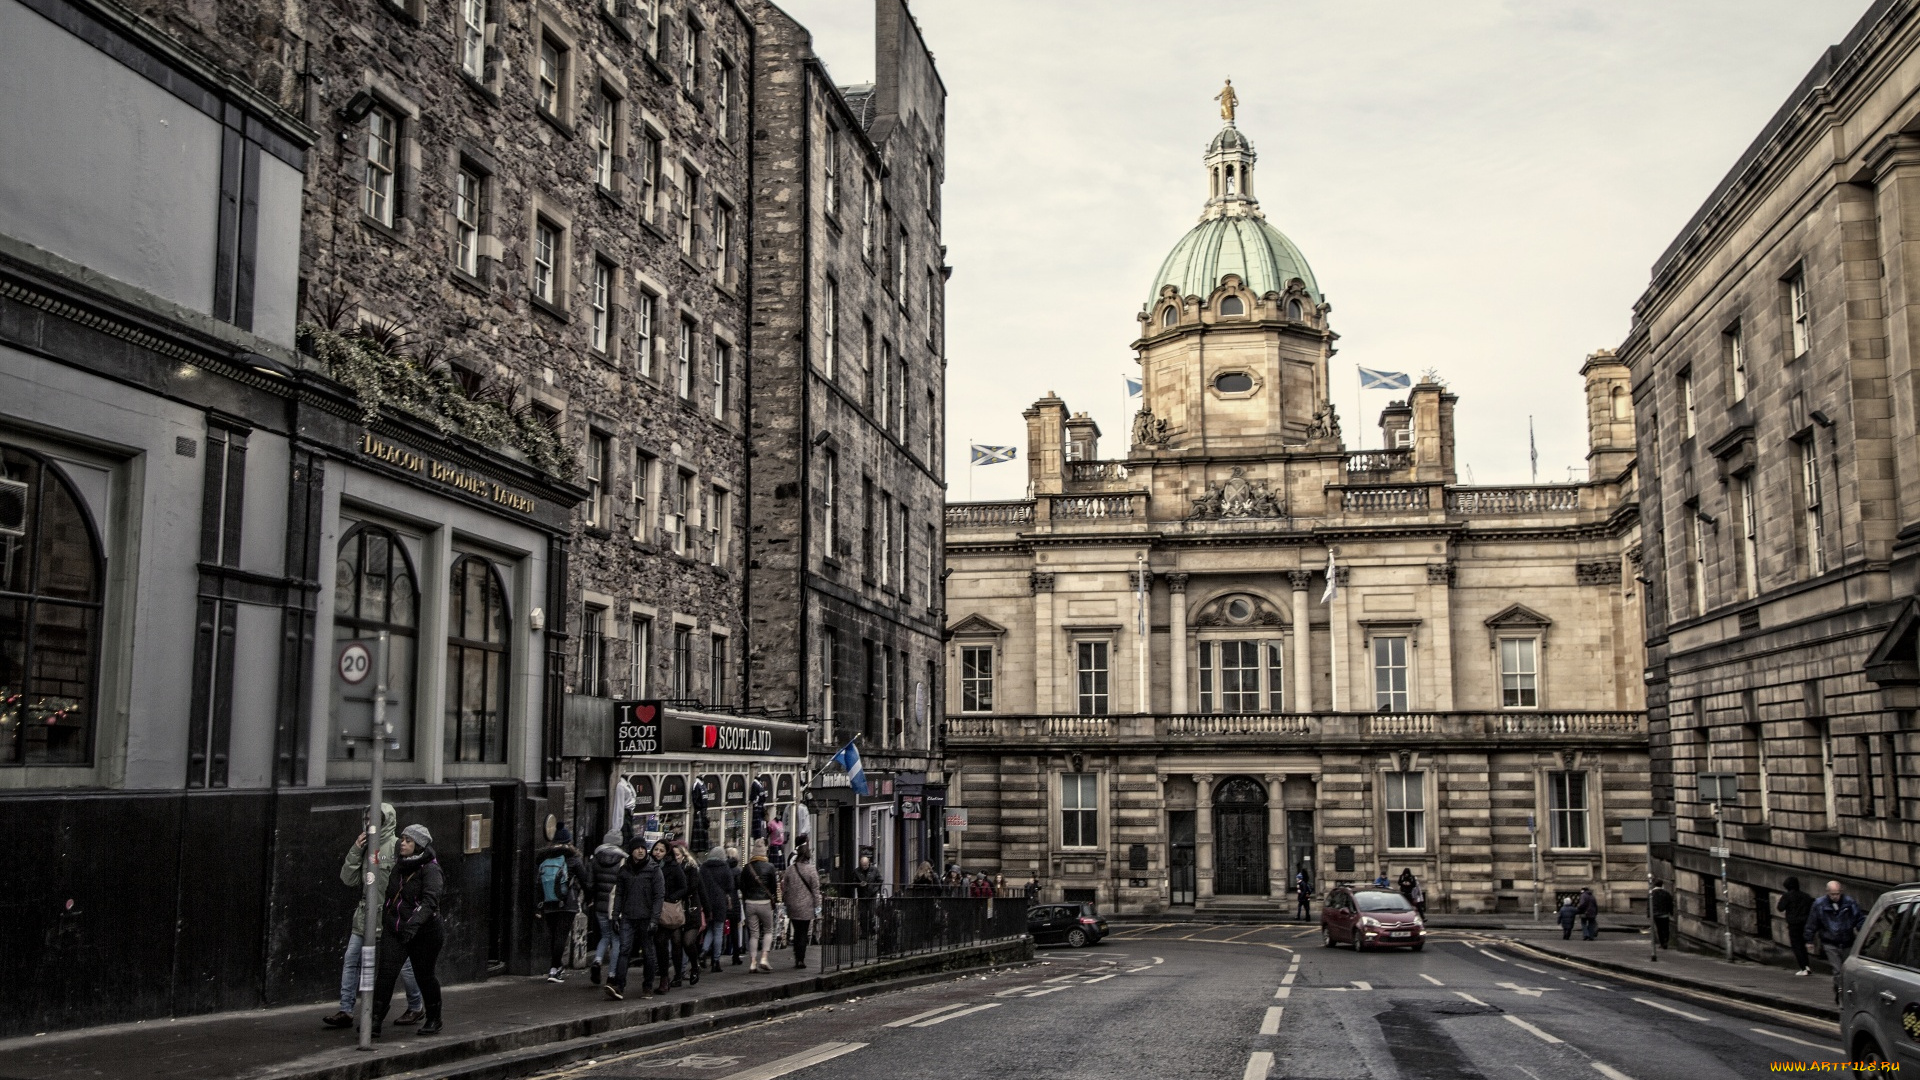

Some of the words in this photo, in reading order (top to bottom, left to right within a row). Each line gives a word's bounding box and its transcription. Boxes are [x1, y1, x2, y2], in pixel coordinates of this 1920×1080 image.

[364, 433, 424, 471] DEACON
[492, 483, 535, 513] TAVERN
[343, 655, 367, 673] 20
[620, 705, 632, 725] I
[618, 725, 657, 739] SCOT
[702, 724, 707, 748] I
[718, 726, 772, 751] SCOTLAND
[618, 739, 657, 752] LAND
